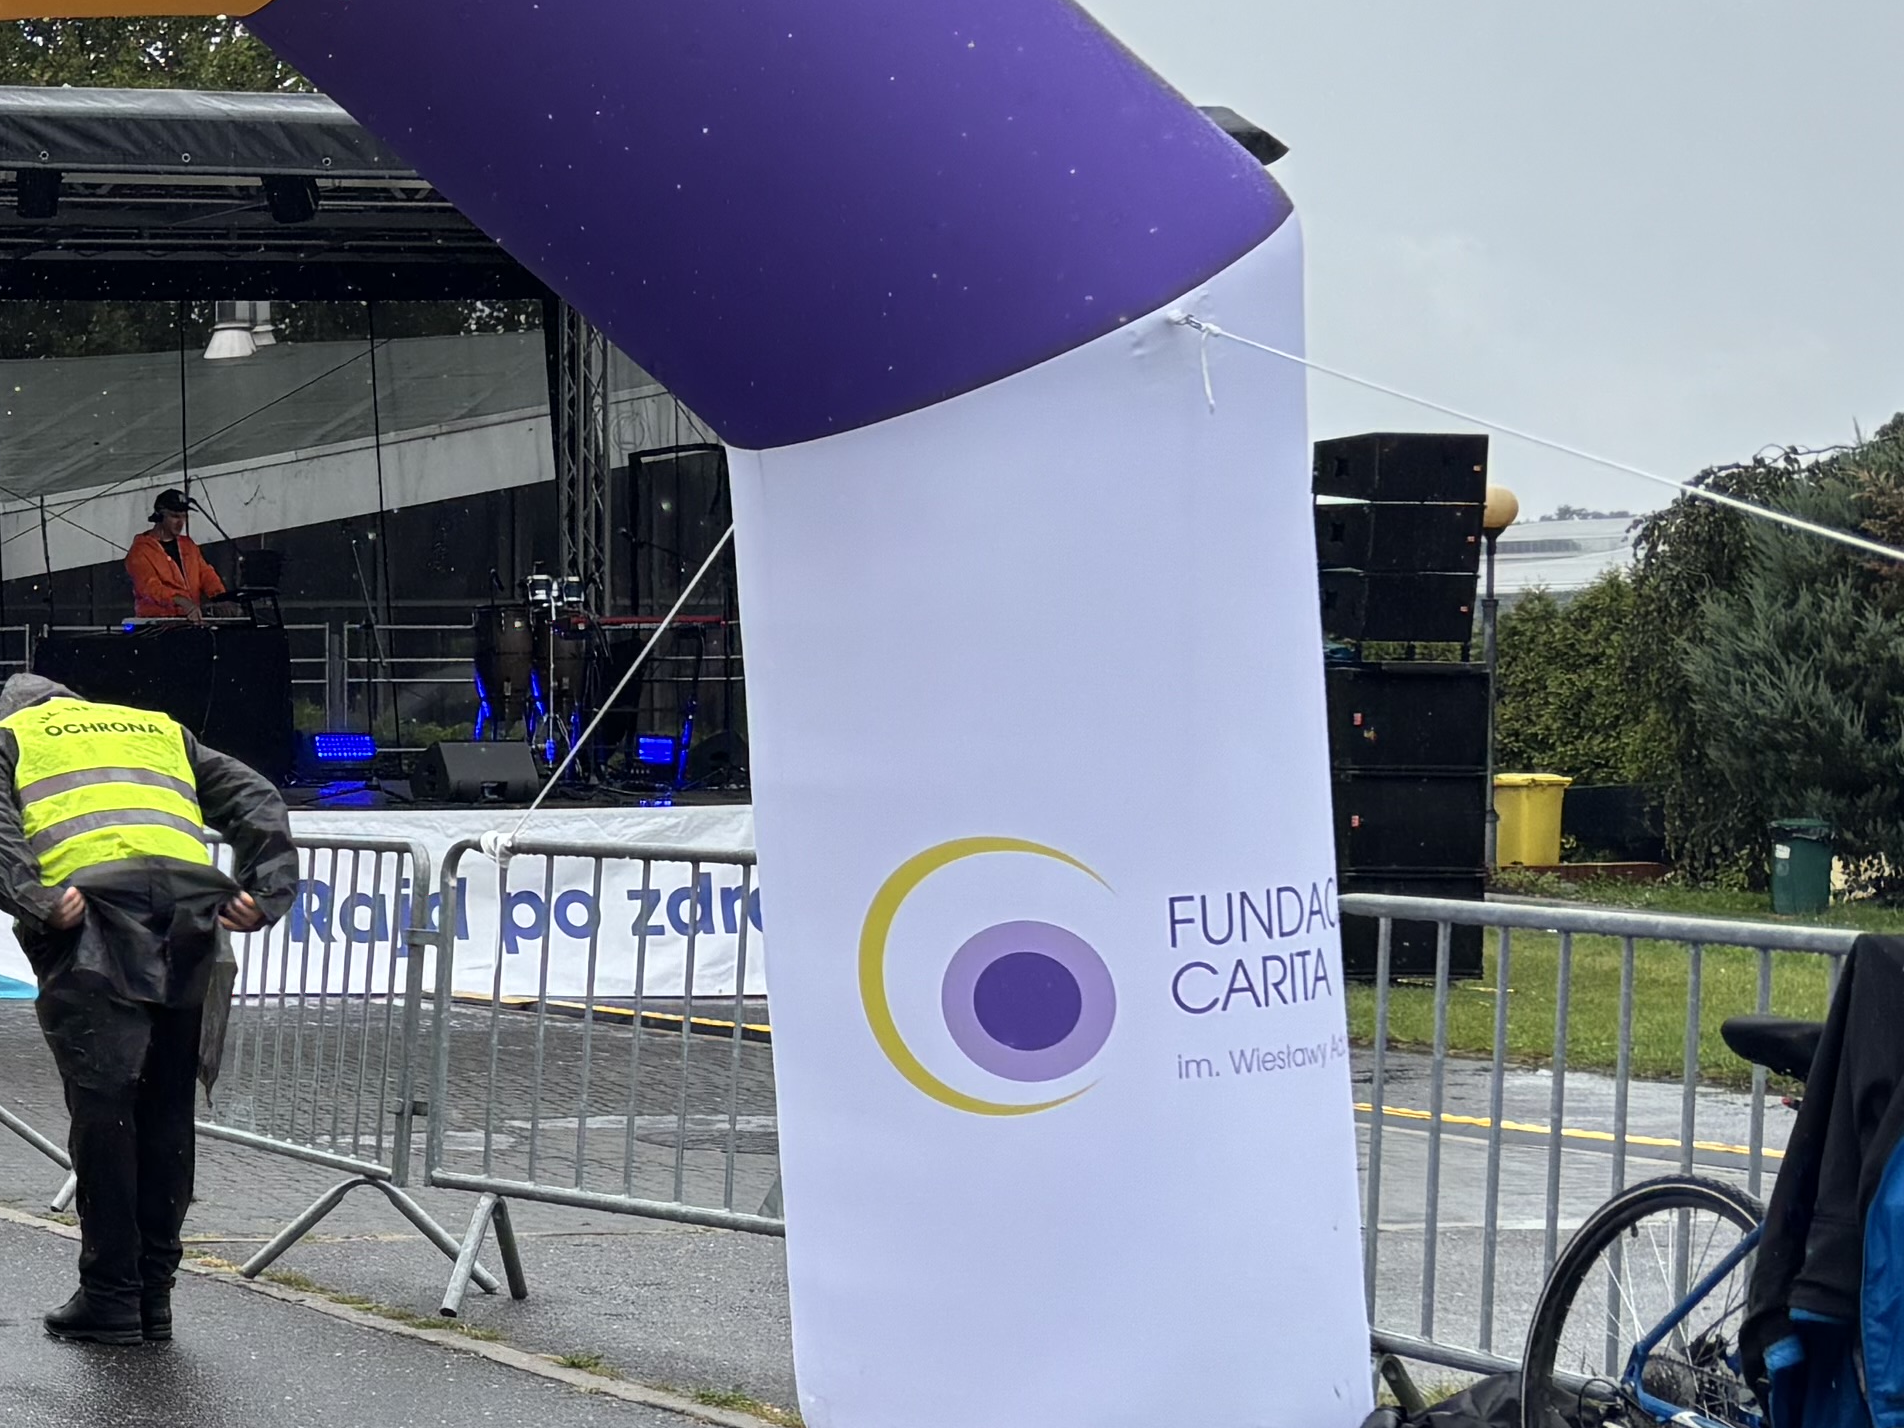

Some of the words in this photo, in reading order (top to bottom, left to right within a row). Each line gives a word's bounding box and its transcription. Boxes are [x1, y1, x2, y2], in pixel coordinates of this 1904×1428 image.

[44, 722, 164, 737] OCHRONA
[504, 888, 594, 955] po
[1171, 947, 1333, 1014] CARITA
[1177, 1054, 1221, 1080] im.
